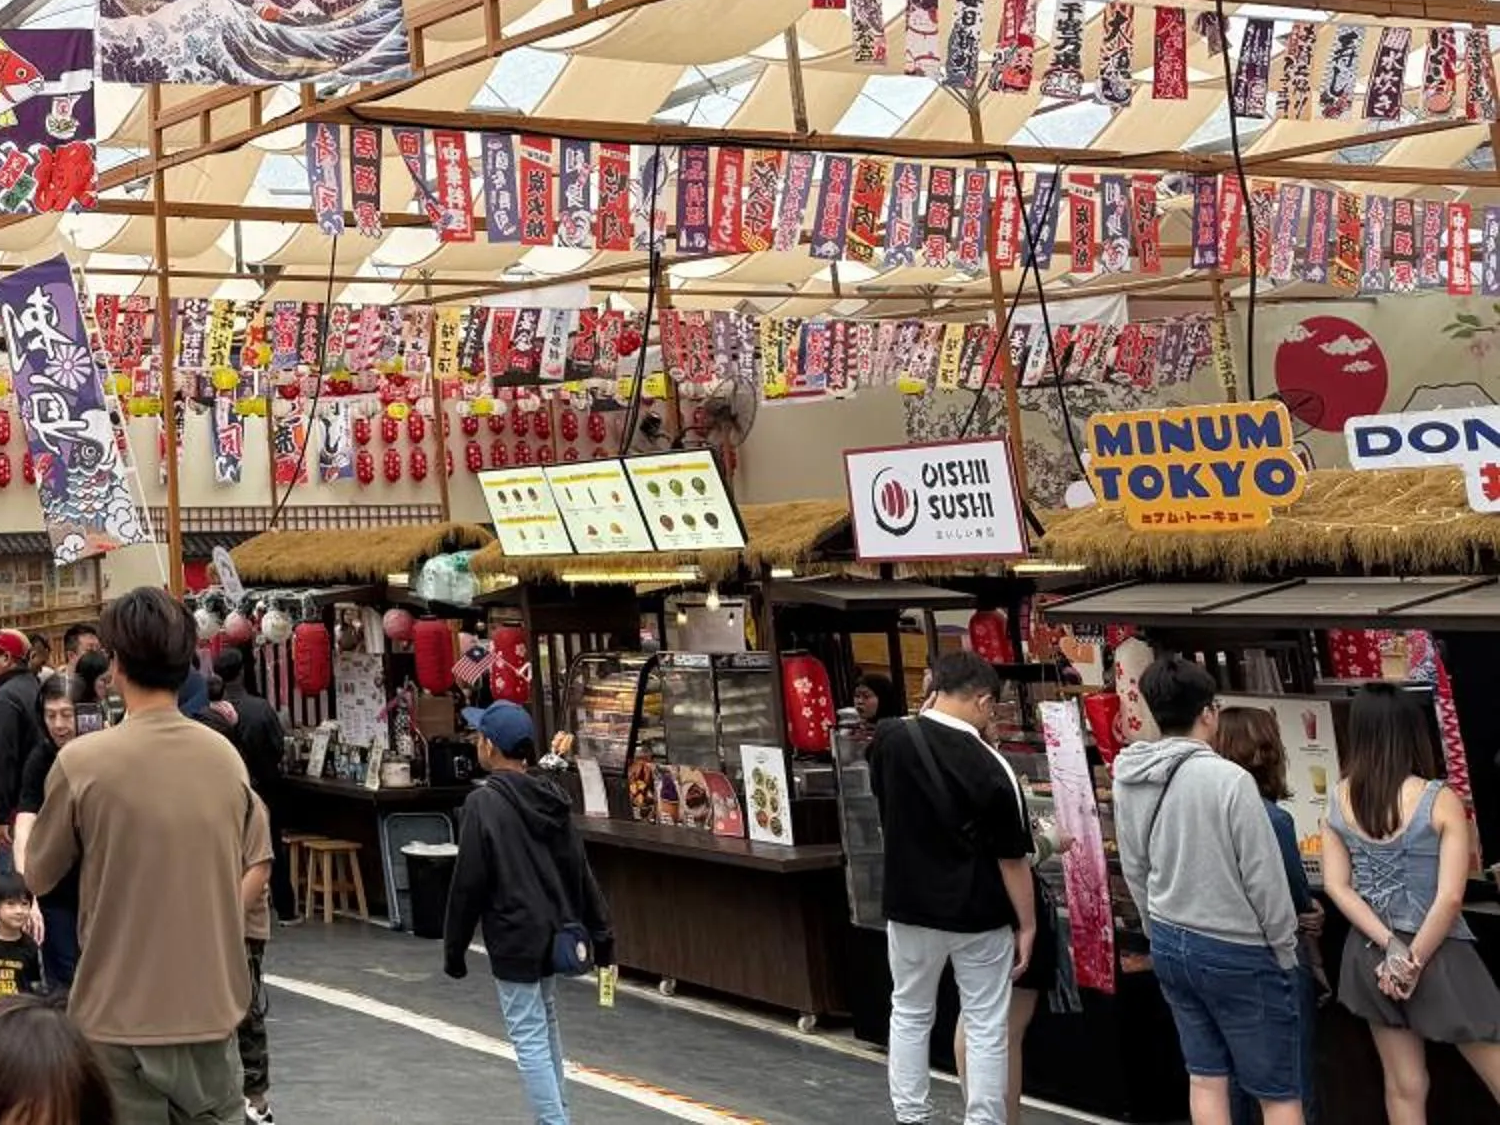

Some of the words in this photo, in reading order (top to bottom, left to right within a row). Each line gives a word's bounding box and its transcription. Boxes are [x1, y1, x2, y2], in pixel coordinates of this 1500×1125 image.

[1093, 410, 1283, 457] MINUM
[921, 458, 991, 489] OISHII
[1094, 458, 1297, 502] TOKYO
[928, 492, 995, 520] SUSHI
